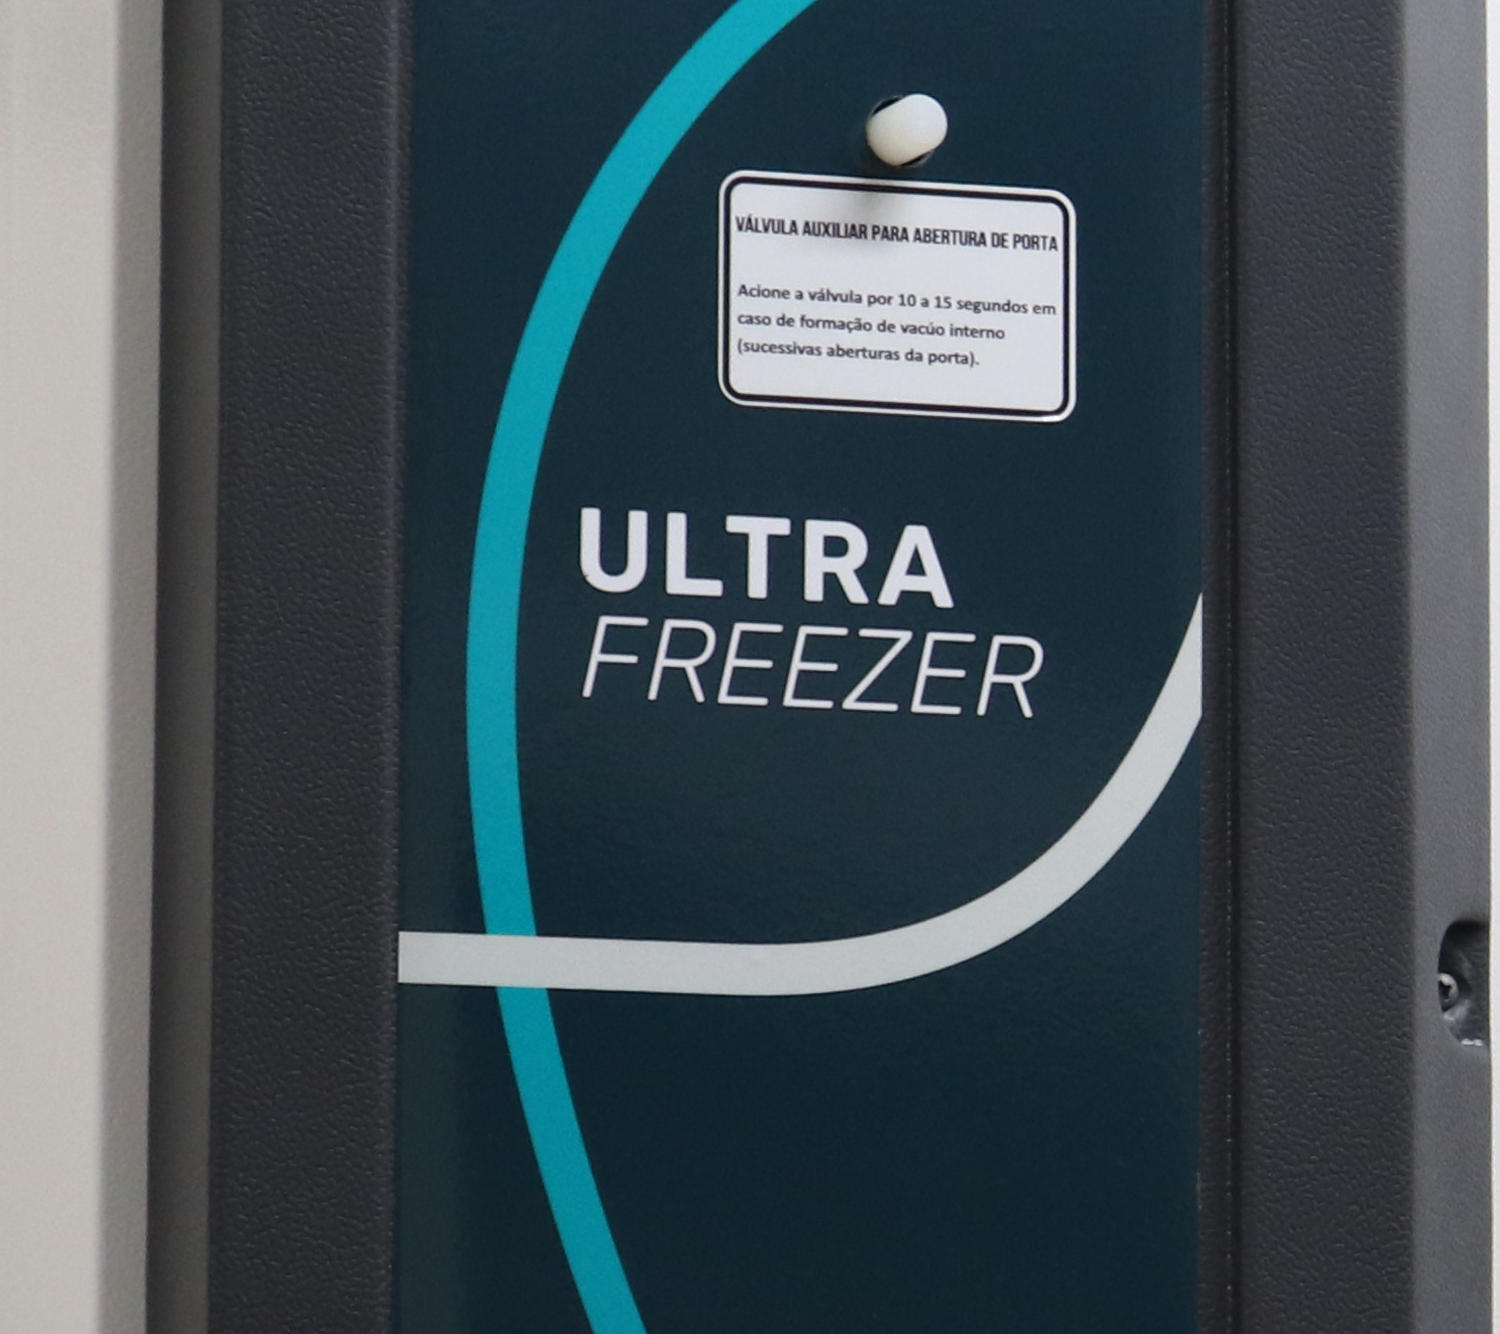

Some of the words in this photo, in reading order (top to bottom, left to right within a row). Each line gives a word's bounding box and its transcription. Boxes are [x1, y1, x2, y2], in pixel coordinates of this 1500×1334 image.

[736, 215, 798, 235] VÁLVULA
[803, 221, 867, 239] AUXILIAR
[872, 225, 909, 241] PARA
[913, 228, 987, 247] ABERTURA
[991, 232, 1008, 248] DE
[1013, 234, 1058, 251] PORTA
[738, 284, 790, 299] Acione
[795, 291, 803, 300] a
[808, 289, 862, 303] válvula
[867, 295, 893, 307] por
[899, 294, 916, 307] 10
[921, 298, 929, 307] a
[935, 296, 952, 309] 15
[957, 300, 1028, 314] segundos
[1033, 305, 1056, 315] em
[737, 315, 771, 326] caso
[776, 314, 795, 327] de
[800, 315, 872, 333] formação
[877, 320, 896, 333] de
[901, 323, 945, 336] vacúo
[950, 324, 1005, 339] interno
[737, 338, 822, 356] (sucessivas
[827, 344, 900, 360] aberturas
[905, 349, 923, 362] da
[928, 352, 979, 367] porta).
[581, 508, 953, 608] ULTRA
[583, 616, 1043, 717] FREEZER
